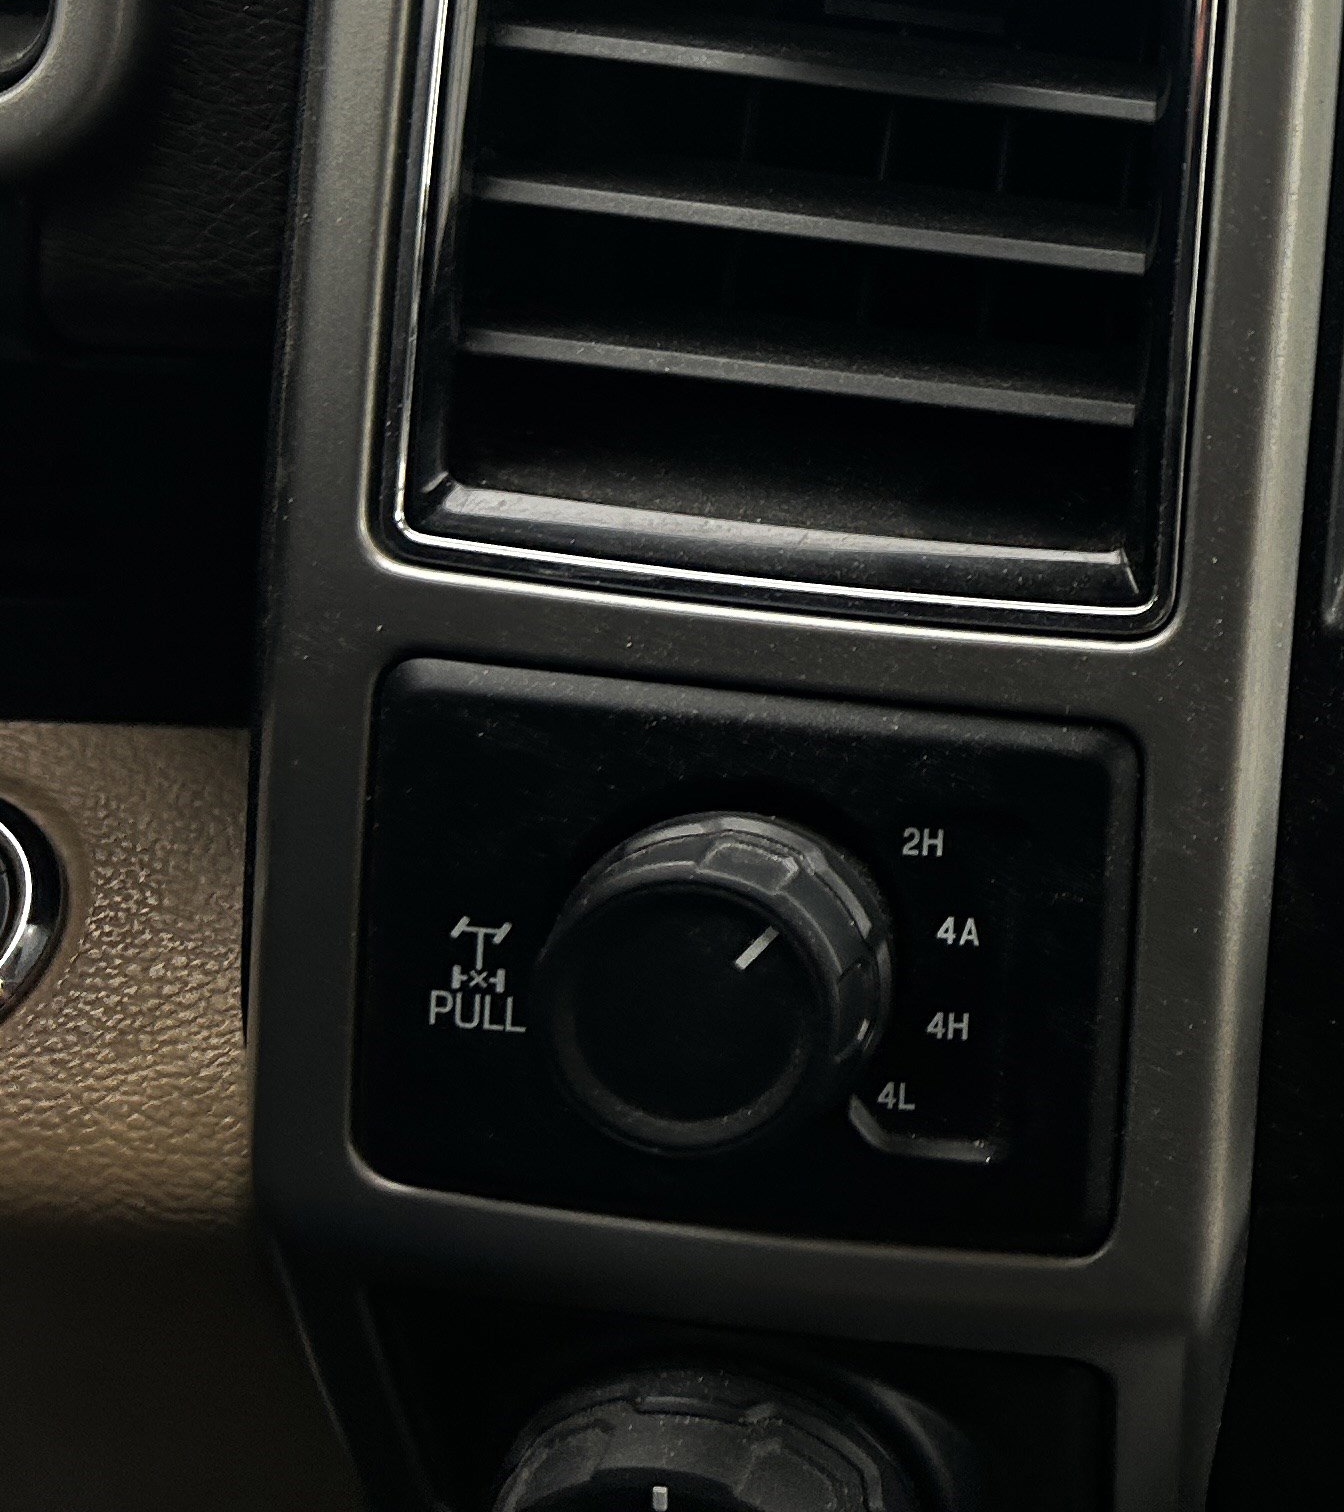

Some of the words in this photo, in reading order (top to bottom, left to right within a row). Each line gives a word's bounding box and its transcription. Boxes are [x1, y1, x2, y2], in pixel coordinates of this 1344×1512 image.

[902, 827, 944, 857] 2H
[936, 916, 980, 946] 4A
[429, 987, 527, 1033] PULL
[926, 1011, 970, 1041] 4H
[876, 1081, 916, 1111] 4L
